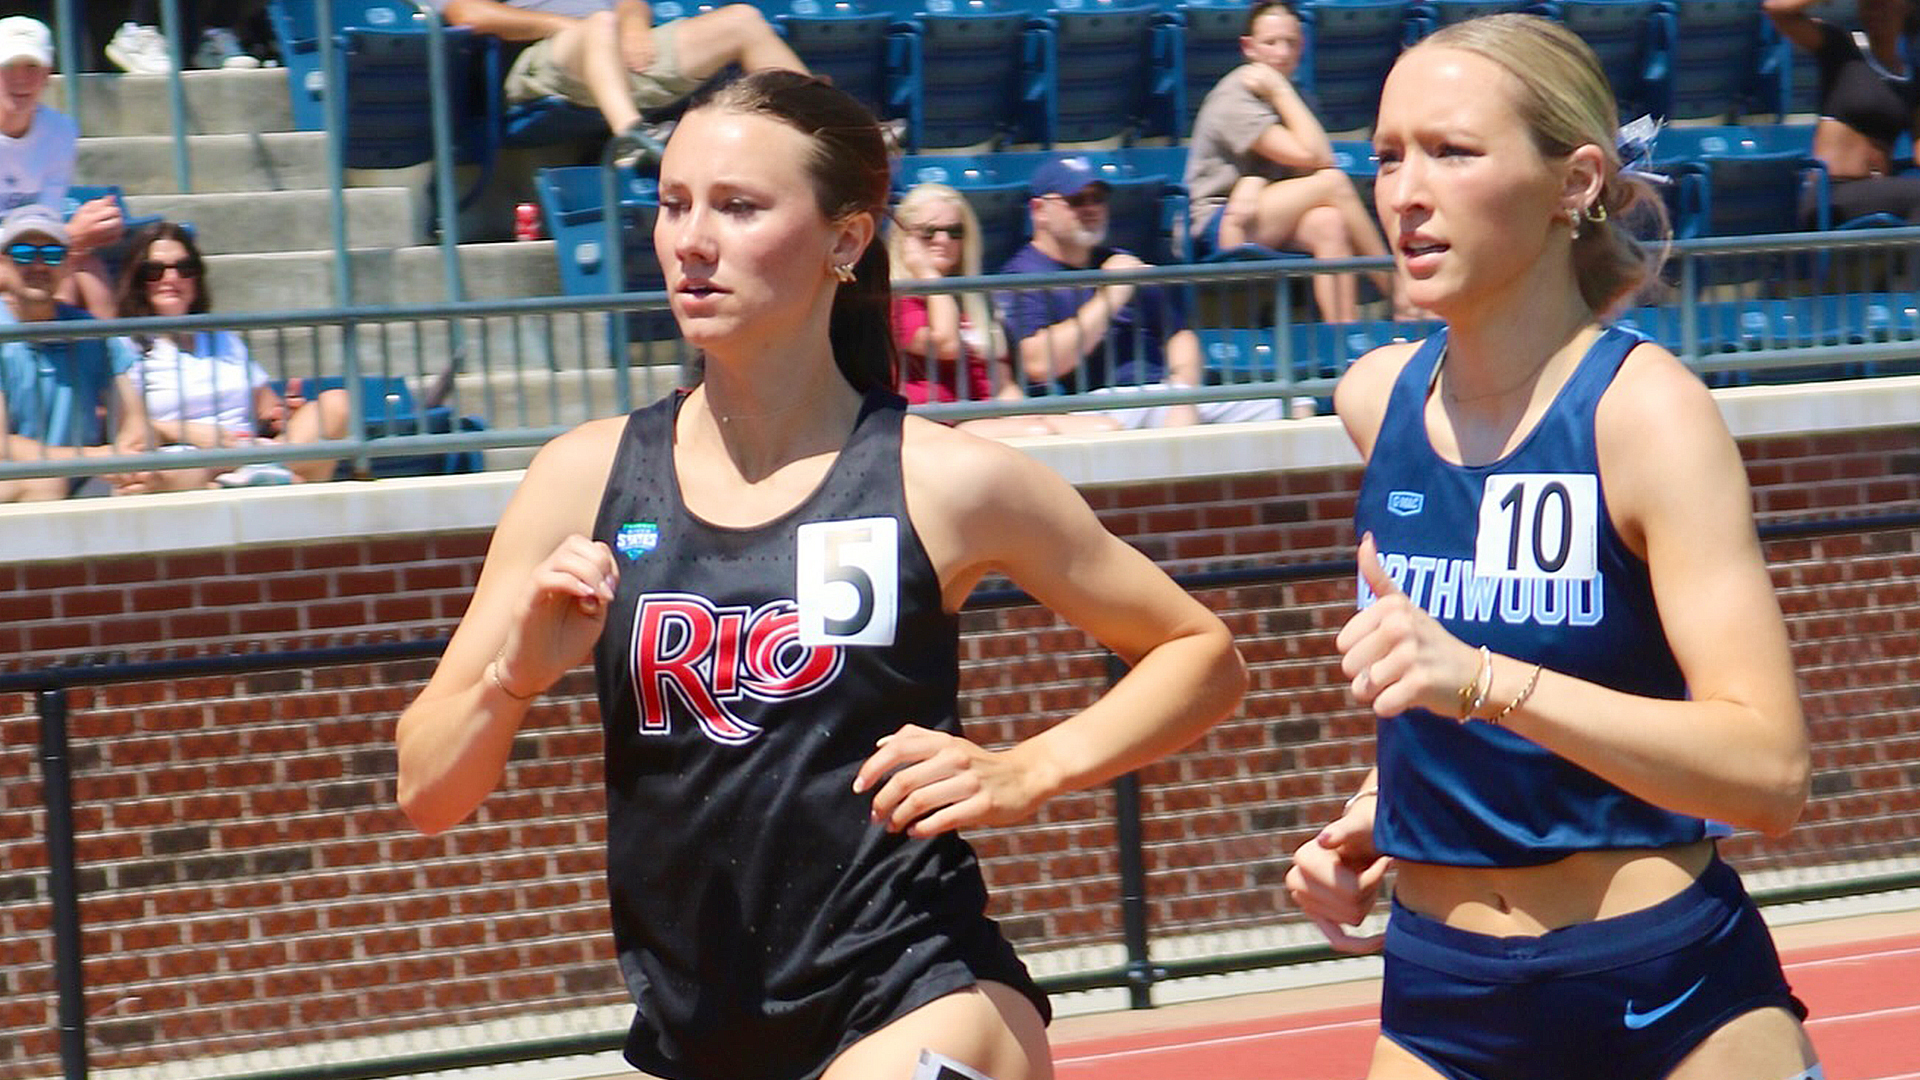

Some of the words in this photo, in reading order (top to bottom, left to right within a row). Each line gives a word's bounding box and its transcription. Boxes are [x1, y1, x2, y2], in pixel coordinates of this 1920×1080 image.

[1500, 481, 1572, 573] 10
[824, 527, 875, 637] 5
[1357, 552, 1604, 626] RTHWOOD
